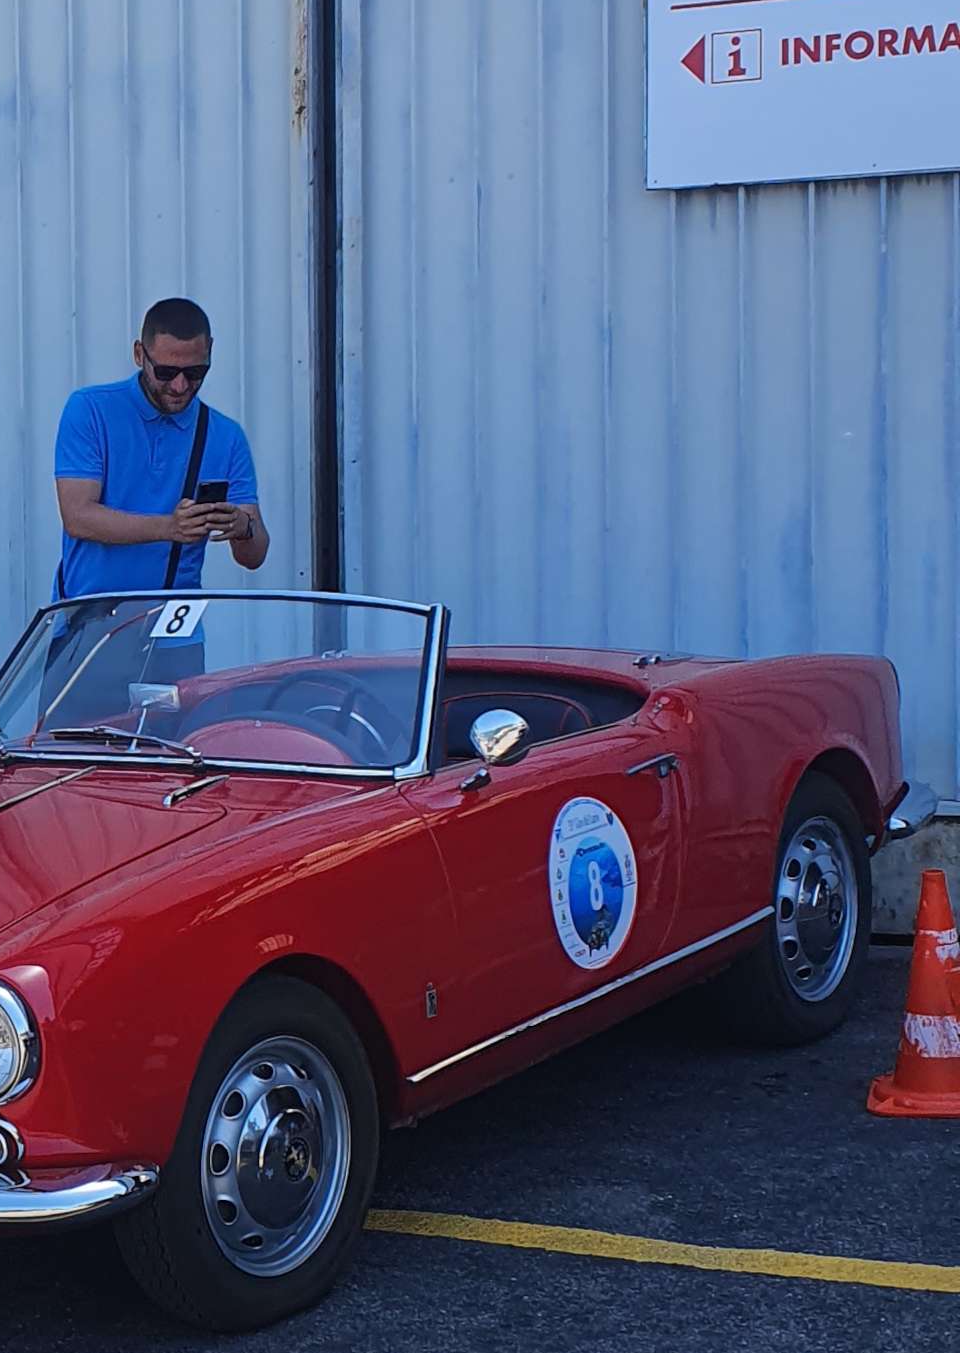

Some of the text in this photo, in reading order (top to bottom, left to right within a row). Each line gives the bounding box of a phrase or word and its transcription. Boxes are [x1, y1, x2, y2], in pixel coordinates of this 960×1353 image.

[781, 23, 960, 66] INFORMA
[165, 605, 191, 634] 8
[588, 861, 604, 911] 8
